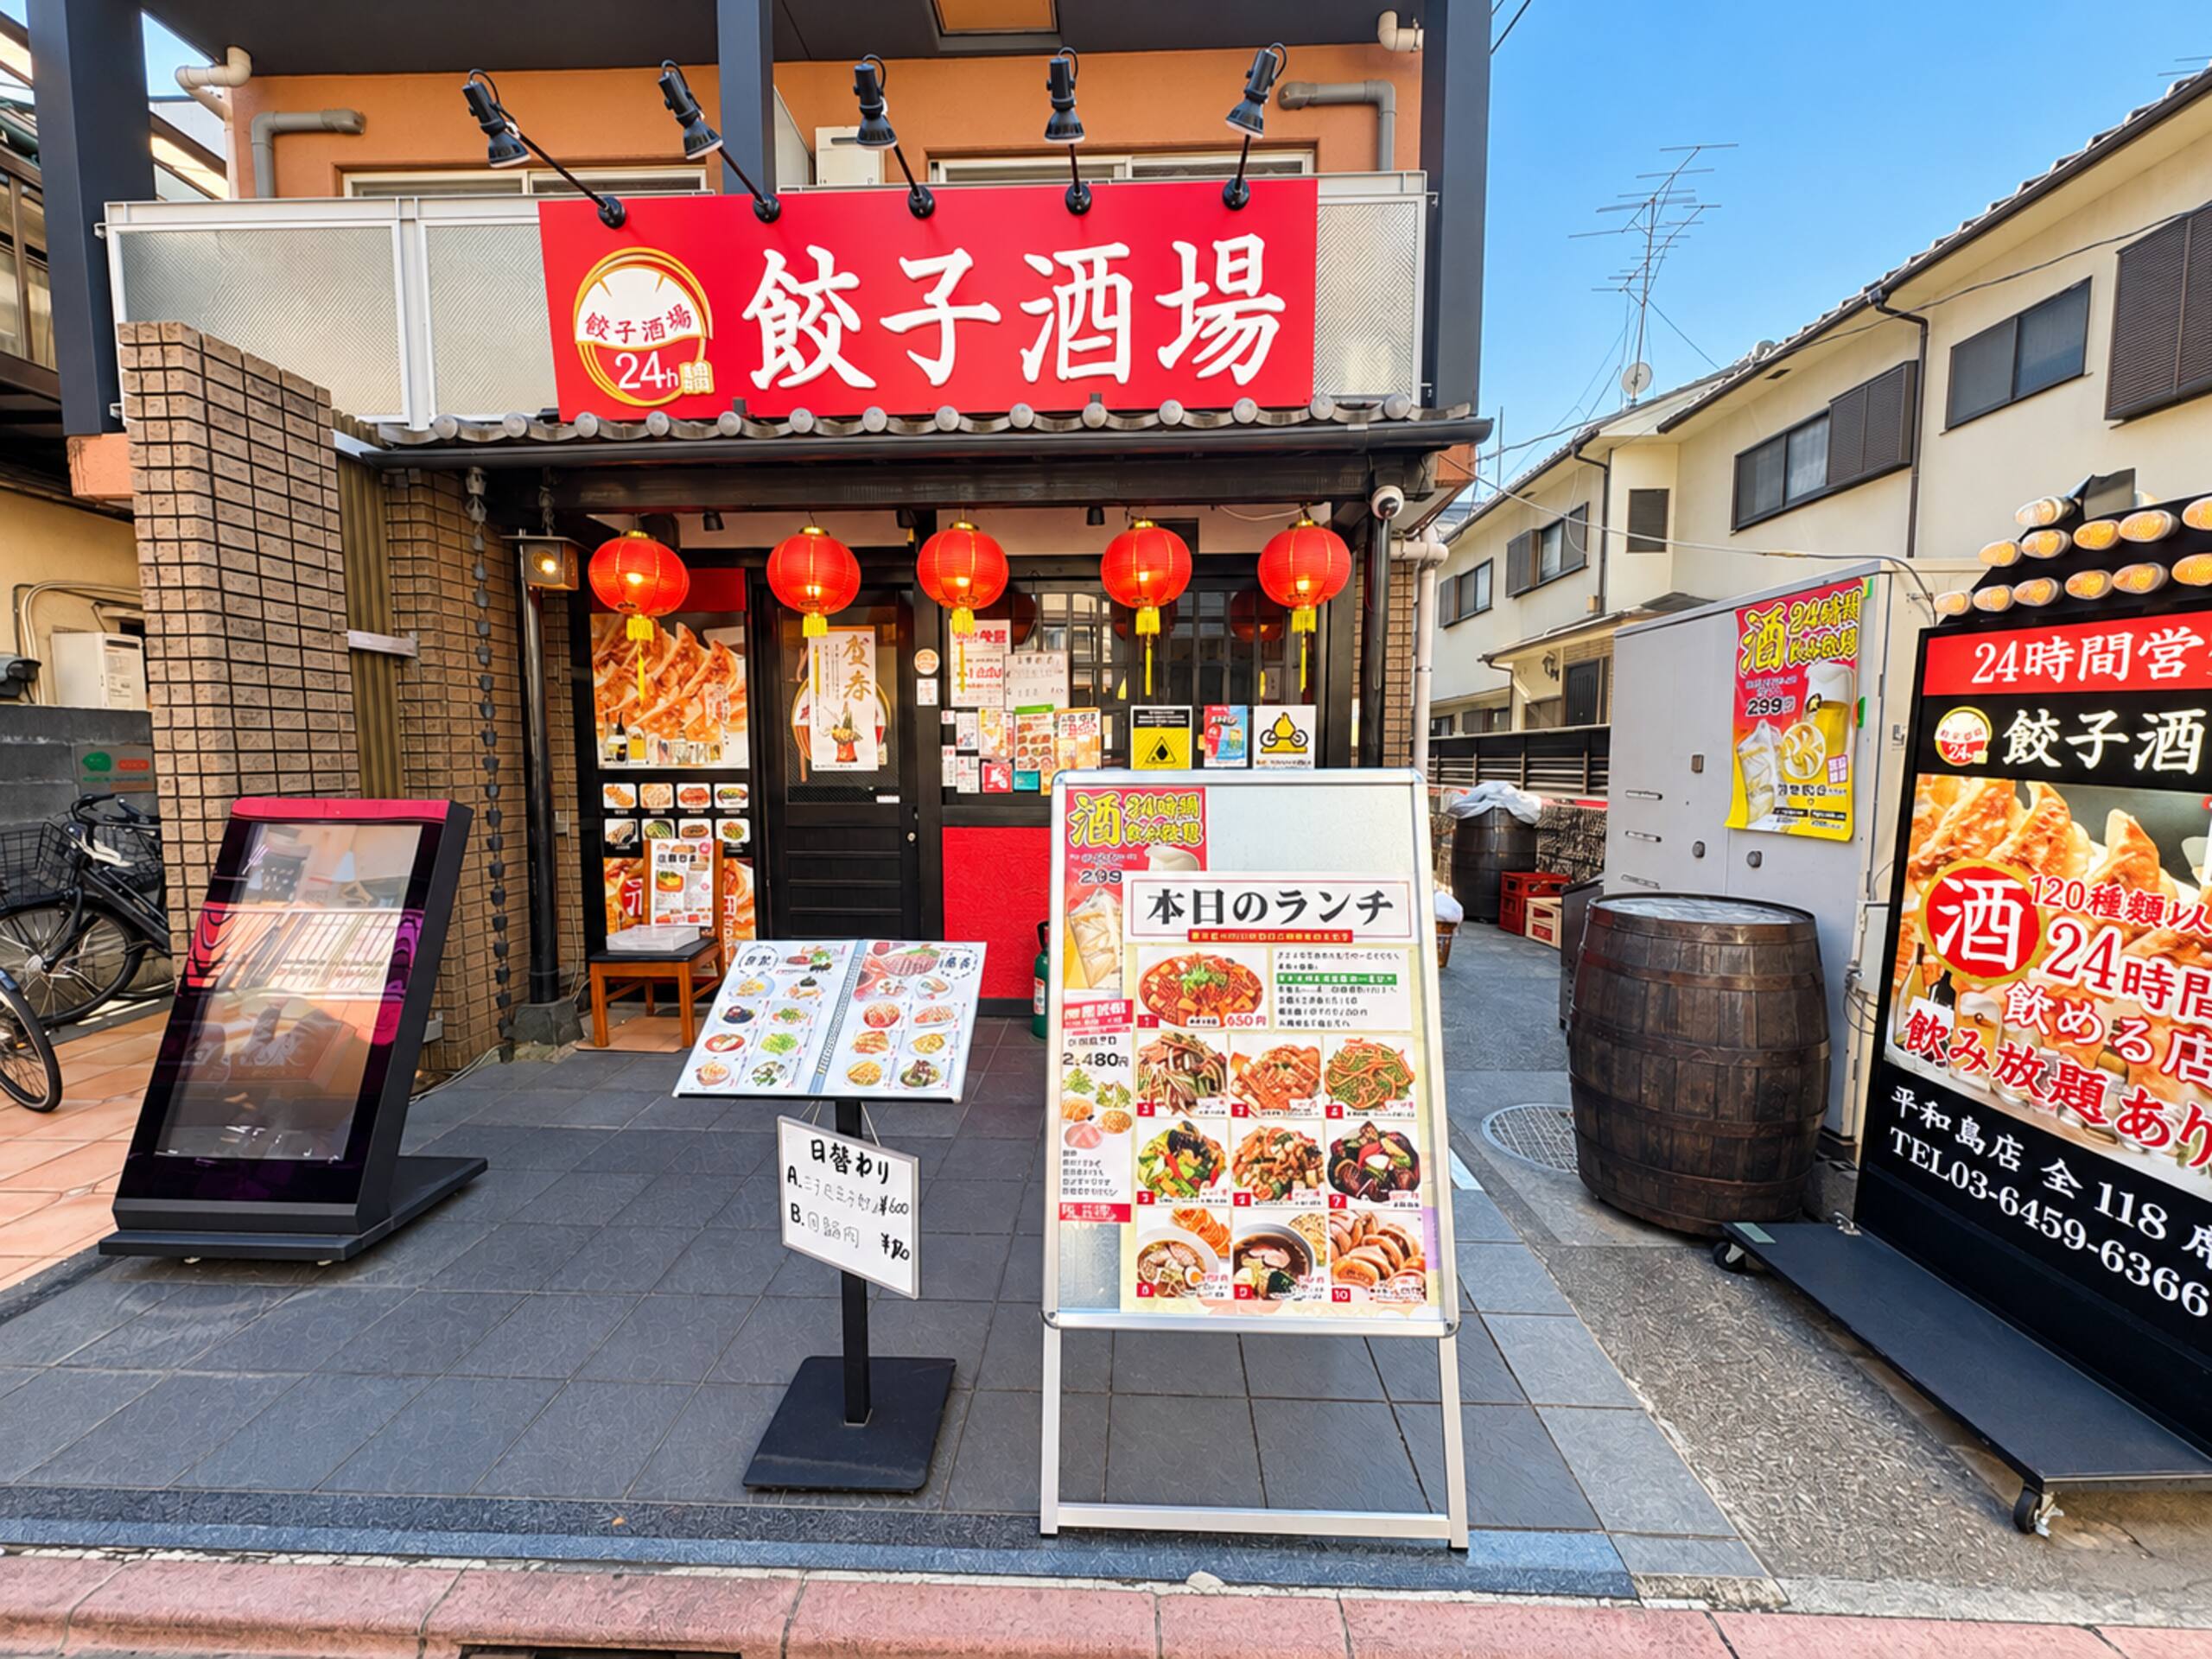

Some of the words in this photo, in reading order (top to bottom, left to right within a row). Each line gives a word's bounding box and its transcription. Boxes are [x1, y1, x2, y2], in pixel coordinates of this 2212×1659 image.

[585, 303, 691, 344] 餃子酒場
[742, 232, 1286, 391] 餃子酒場
[614, 350, 679, 389] 24h
[1971, 626, 2212, 683] 24時間営
[2002, 708, 2207, 775] 餃子酒
[1069, 792, 1122, 846] 酒
[1147, 888, 1394, 926] 本日のランチ
[1936, 877, 2024, 971] 酒
[1904, 1008, 2212, 1168] 飲み放題あり
[810, 1139, 888, 1185] 日替わり
[1891, 1085, 2024, 1173] 平和島店
[2040, 1157, 2084, 1200] 全
[2094, 1181, 2169, 1241] 118
[1890, 1126, 2211, 1318] TEL03-6459-6366
